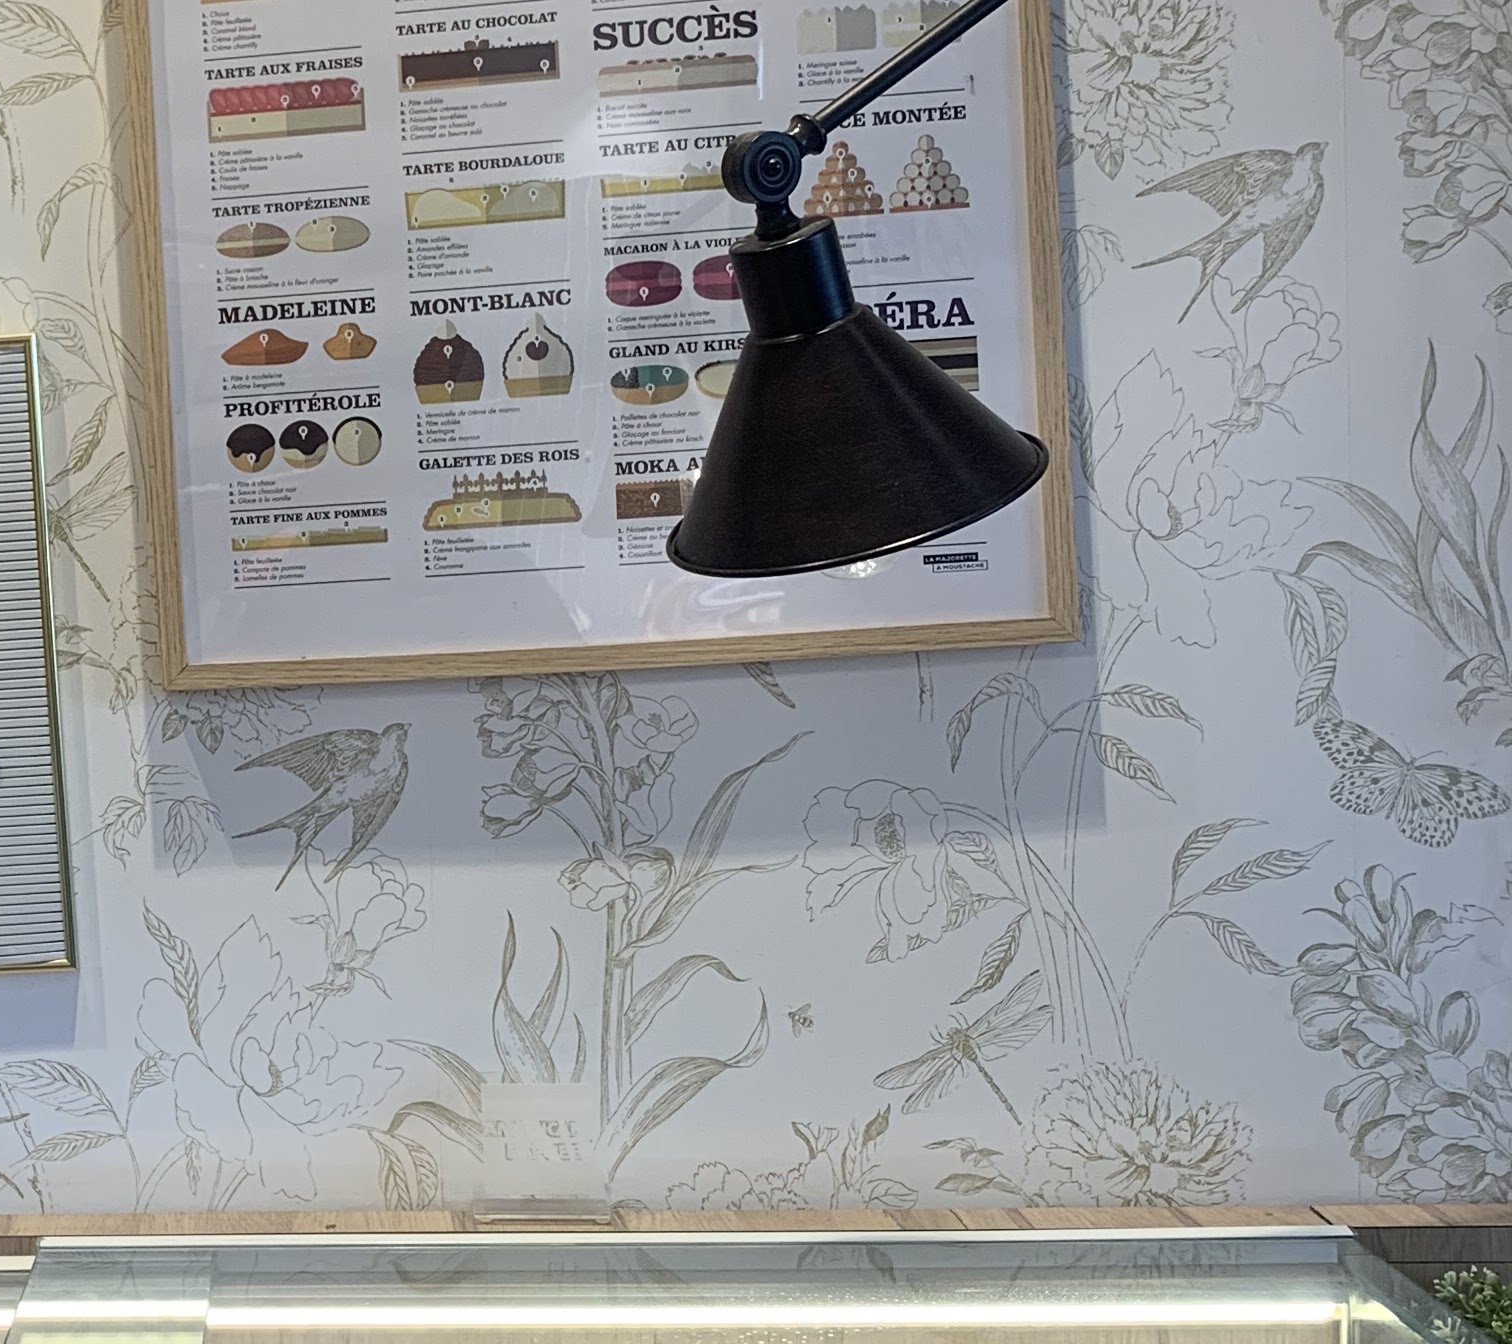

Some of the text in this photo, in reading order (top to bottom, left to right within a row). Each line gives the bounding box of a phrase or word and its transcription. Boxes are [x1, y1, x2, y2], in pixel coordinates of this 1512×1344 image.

[396, 12, 557, 36] TARTE AU CHOCOLAT
[593, 5, 758, 51] SUCCÈS
[205, 57, 363, 80] TARTE AUX FRAISES
[872, 102, 966, 126] MONTÉE
[600, 135, 737, 157] TARTE AU CITR
[403, 153, 564, 176] TARTE BOURDALOUE
[212, 196, 370, 217] TARTE TROPÉZIENNE
[604, 243, 668, 256] MACARON
[672, 240, 681, 251] À
[685, 240, 701, 250] LA
[218, 297, 375, 324] MADELEINE
[410, 289, 571, 316] MONT-BLANC
[864, 292, 975, 330] ÉRA
[609, 343, 669, 359] GLAND
[675, 342, 698, 354] AU
[224, 393, 381, 418] PROFITÉROLE
[419, 449, 579, 470] GALETTE DES ROIS
[615, 458, 680, 475] MOKA
[230, 508, 387, 525] TARTE FINE AUX POMMES
